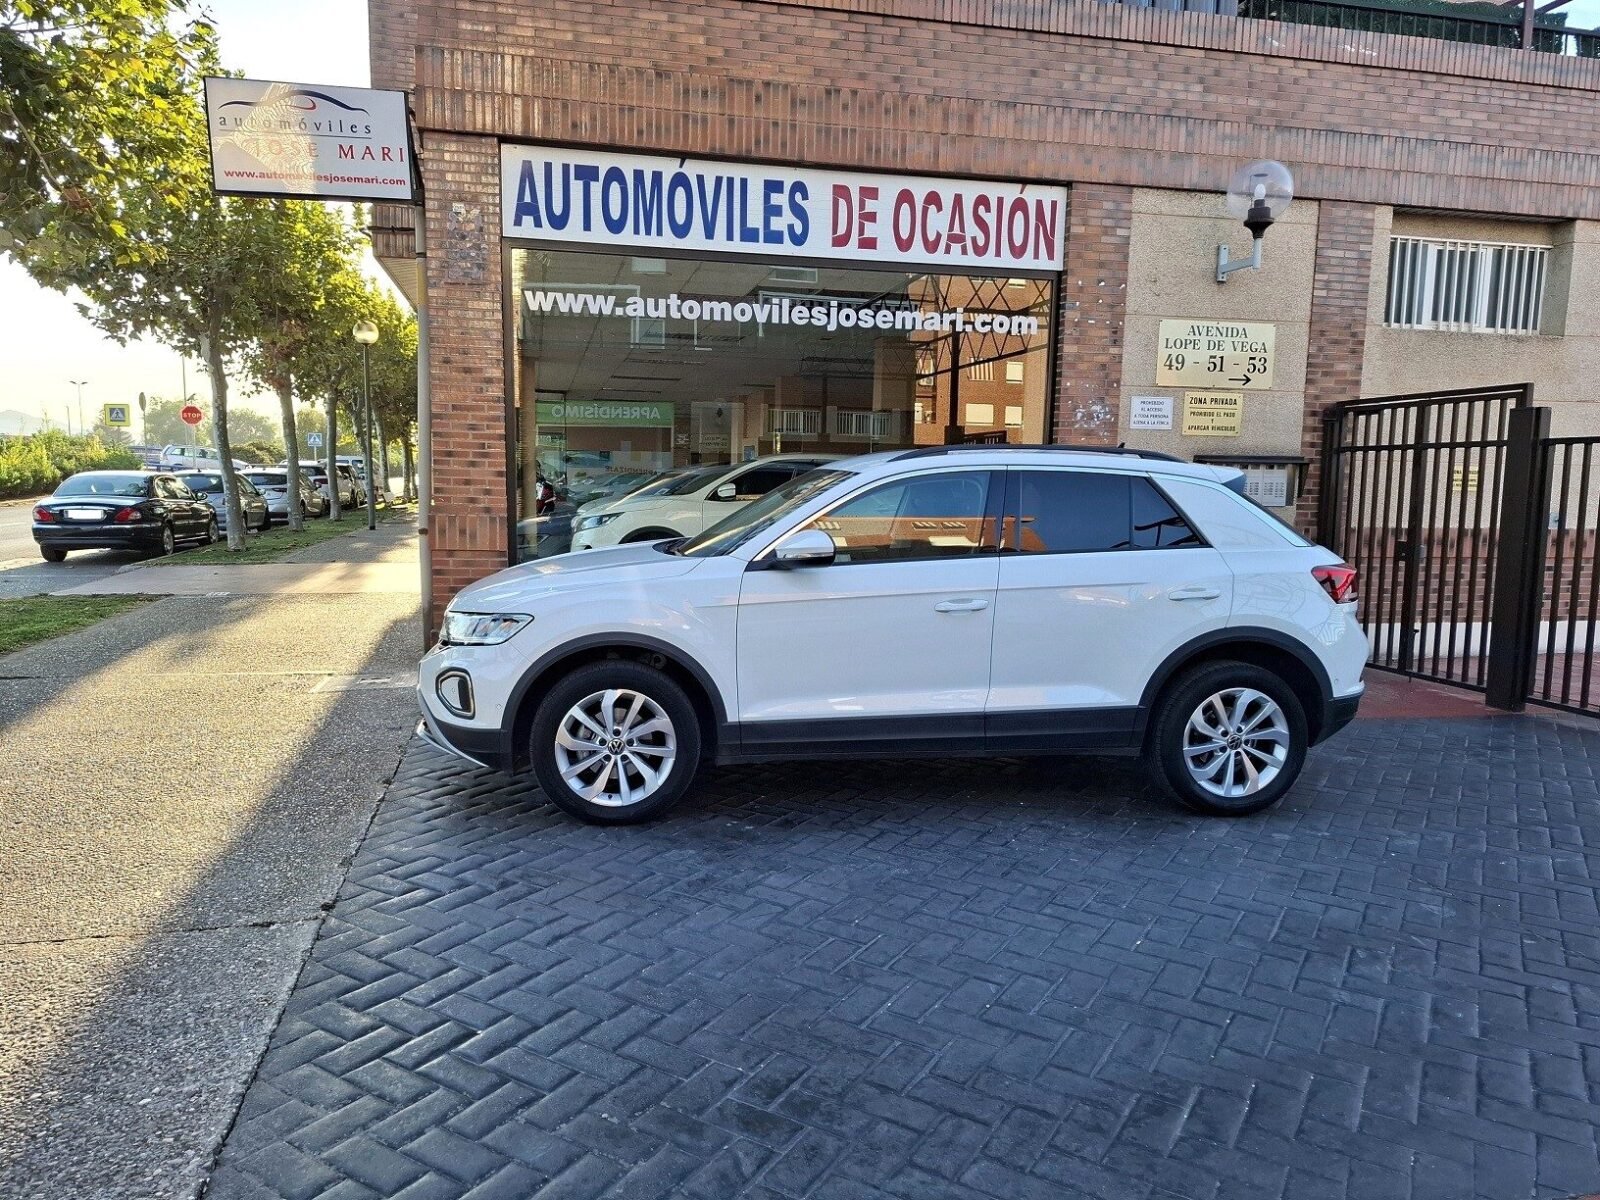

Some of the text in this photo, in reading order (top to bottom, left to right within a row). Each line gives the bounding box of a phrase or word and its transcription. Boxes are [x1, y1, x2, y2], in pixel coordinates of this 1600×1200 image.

[219, 115, 372, 134] automóviles
[338, 144, 405, 162] MARI
[513, 159, 1058, 261] AUTOMÓVILES DE OCASIÓN
[525, 288, 1038, 336] www.automovilesjosemari.com
[1187, 325, 1248, 338] AVENIDA
[1165, 338, 1268, 353] LOPE DE VEGA
[1164, 353, 1185, 371] 49
[1207, 355, 1225, 372] 51
[1247, 356, 1268, 374] 53
[1189, 397, 1238, 406] ZONA PRIVADA
